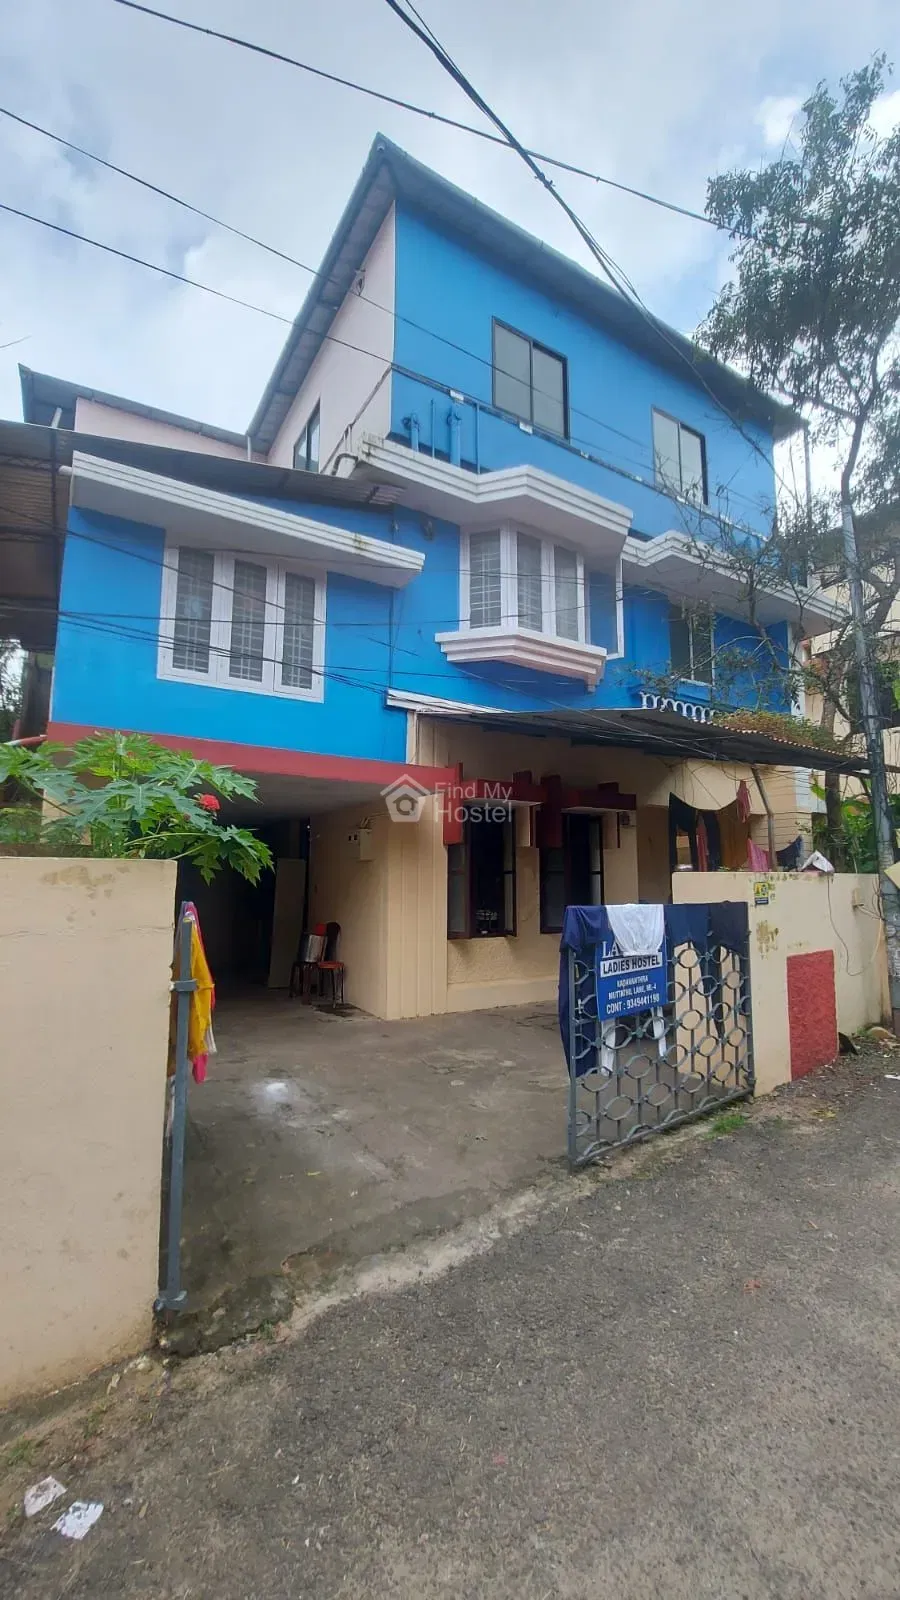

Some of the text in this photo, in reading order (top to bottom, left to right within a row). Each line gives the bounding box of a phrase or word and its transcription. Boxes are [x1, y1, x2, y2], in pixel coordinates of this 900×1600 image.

[603, 955, 661, 975] LADIES HOSTEL
[606, 1001, 623, 1014] CONT
